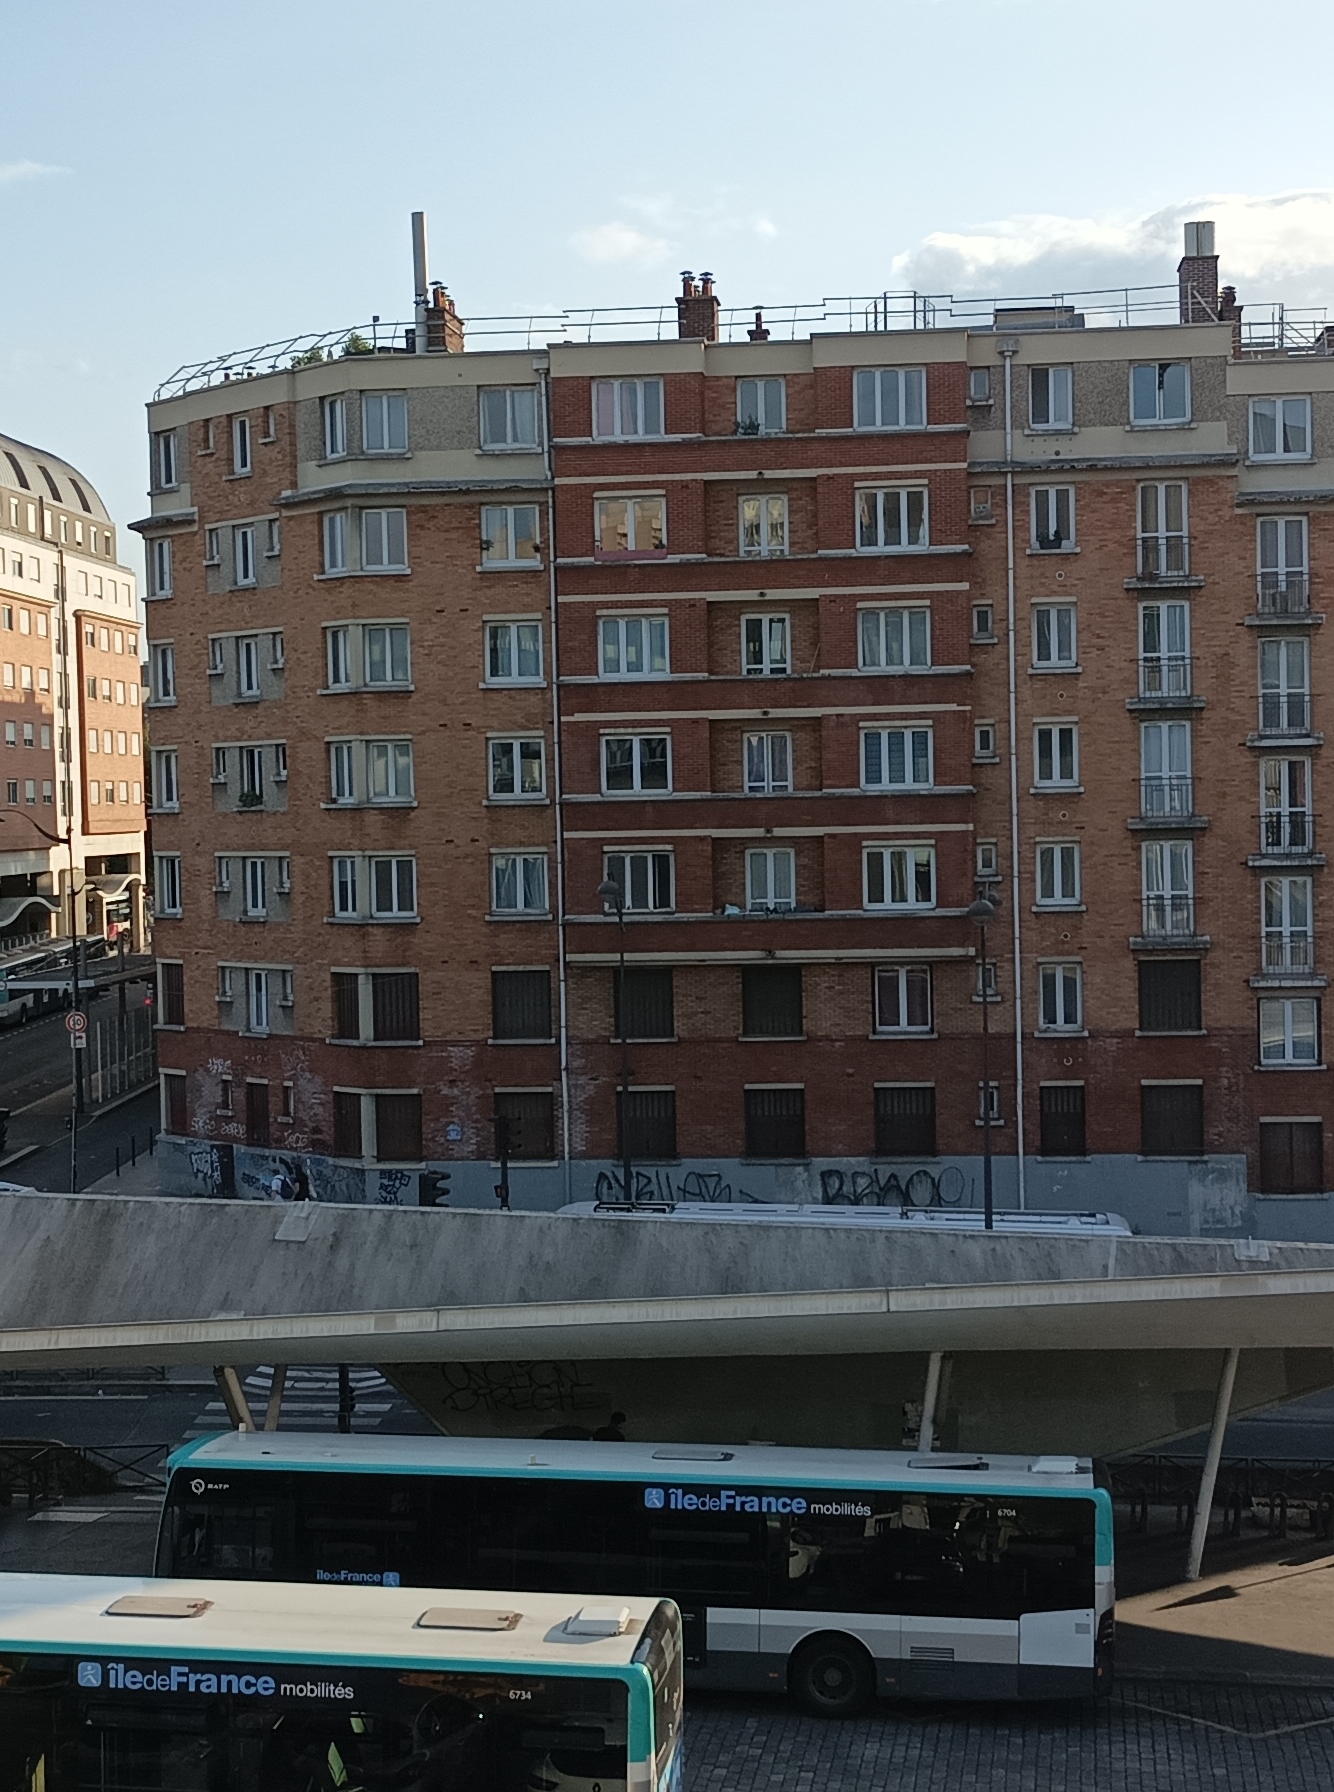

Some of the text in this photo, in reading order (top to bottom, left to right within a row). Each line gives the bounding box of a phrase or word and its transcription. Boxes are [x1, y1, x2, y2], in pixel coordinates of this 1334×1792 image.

[810, 1501, 872, 1516] mobilités
[997, 1509, 1017, 1517] 6704
[280, 1681, 355, 1699] mobilités
[509, 1690, 532, 1700] 6734
